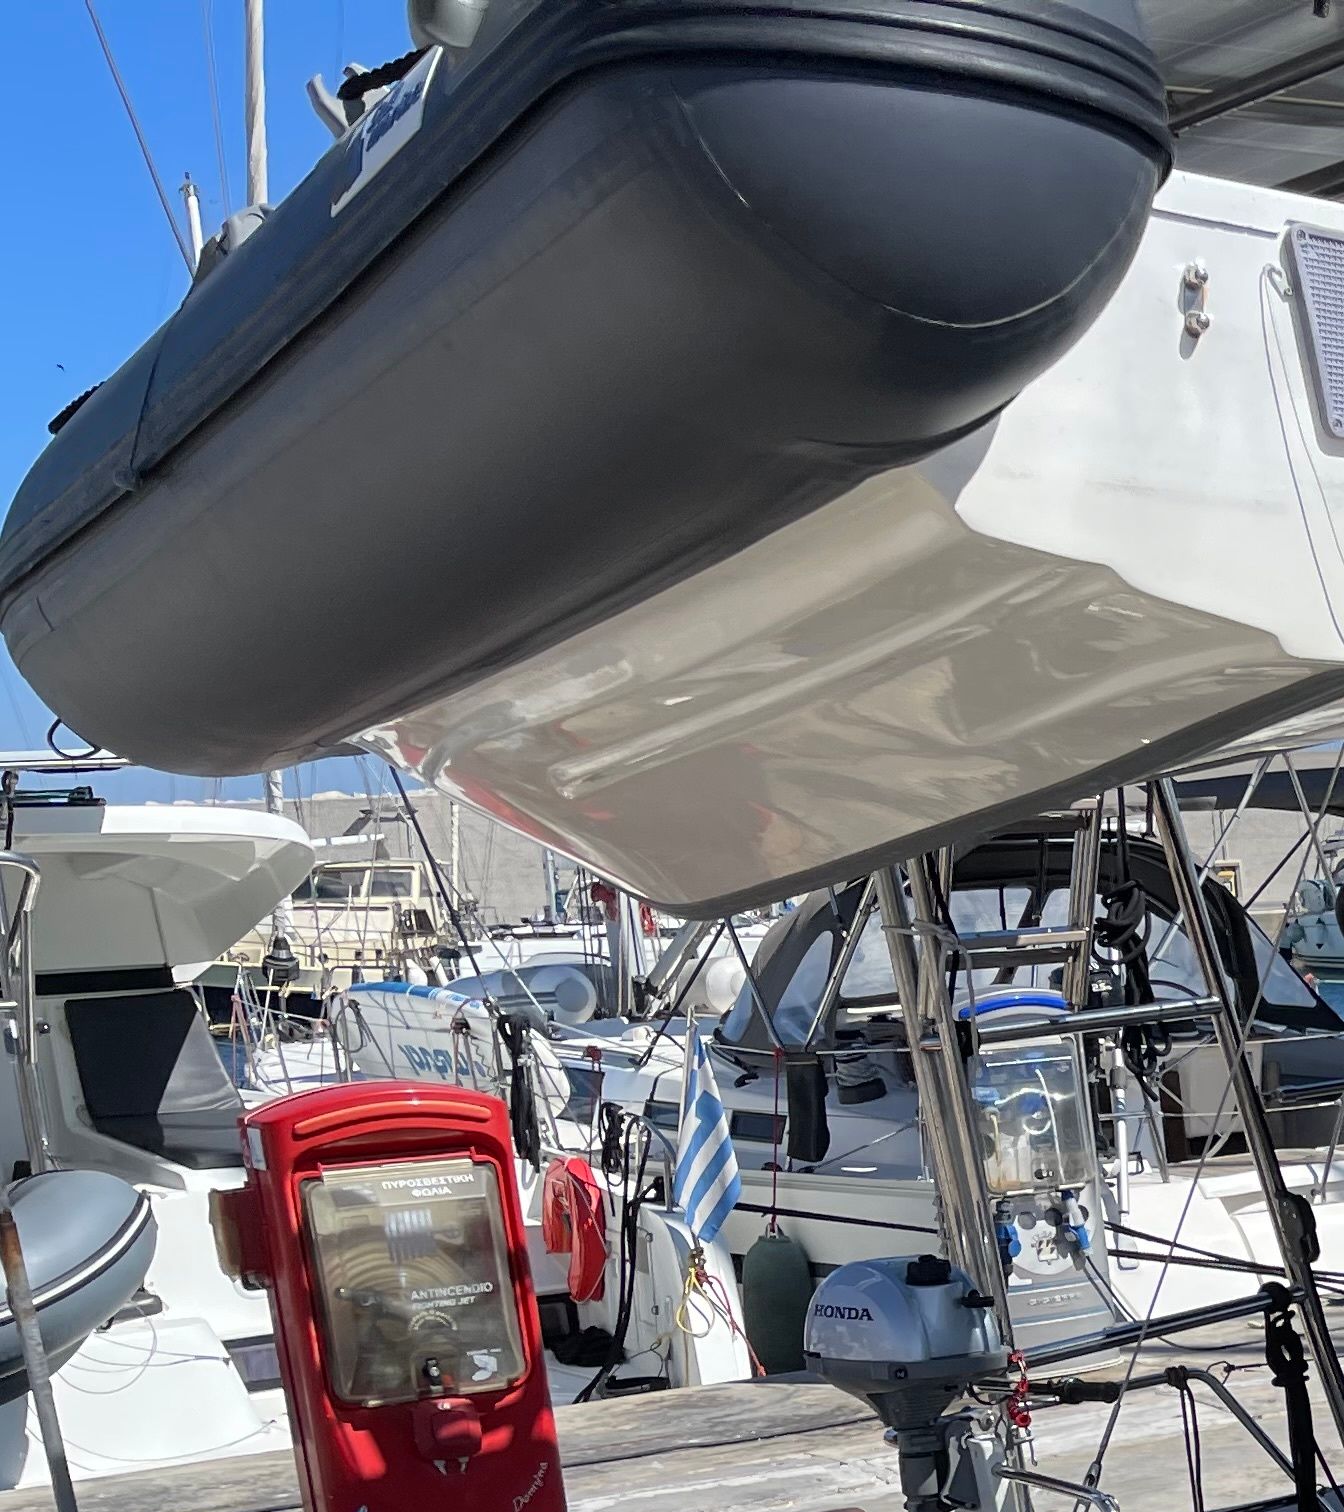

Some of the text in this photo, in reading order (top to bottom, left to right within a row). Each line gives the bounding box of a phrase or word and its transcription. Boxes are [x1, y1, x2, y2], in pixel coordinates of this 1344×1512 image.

[411, 1186, 453, 1198] ΦΩΛΙΑ
[410, 1281, 494, 1301] ANTINCENDIO
[814, 1303, 875, 1322] HONDA
